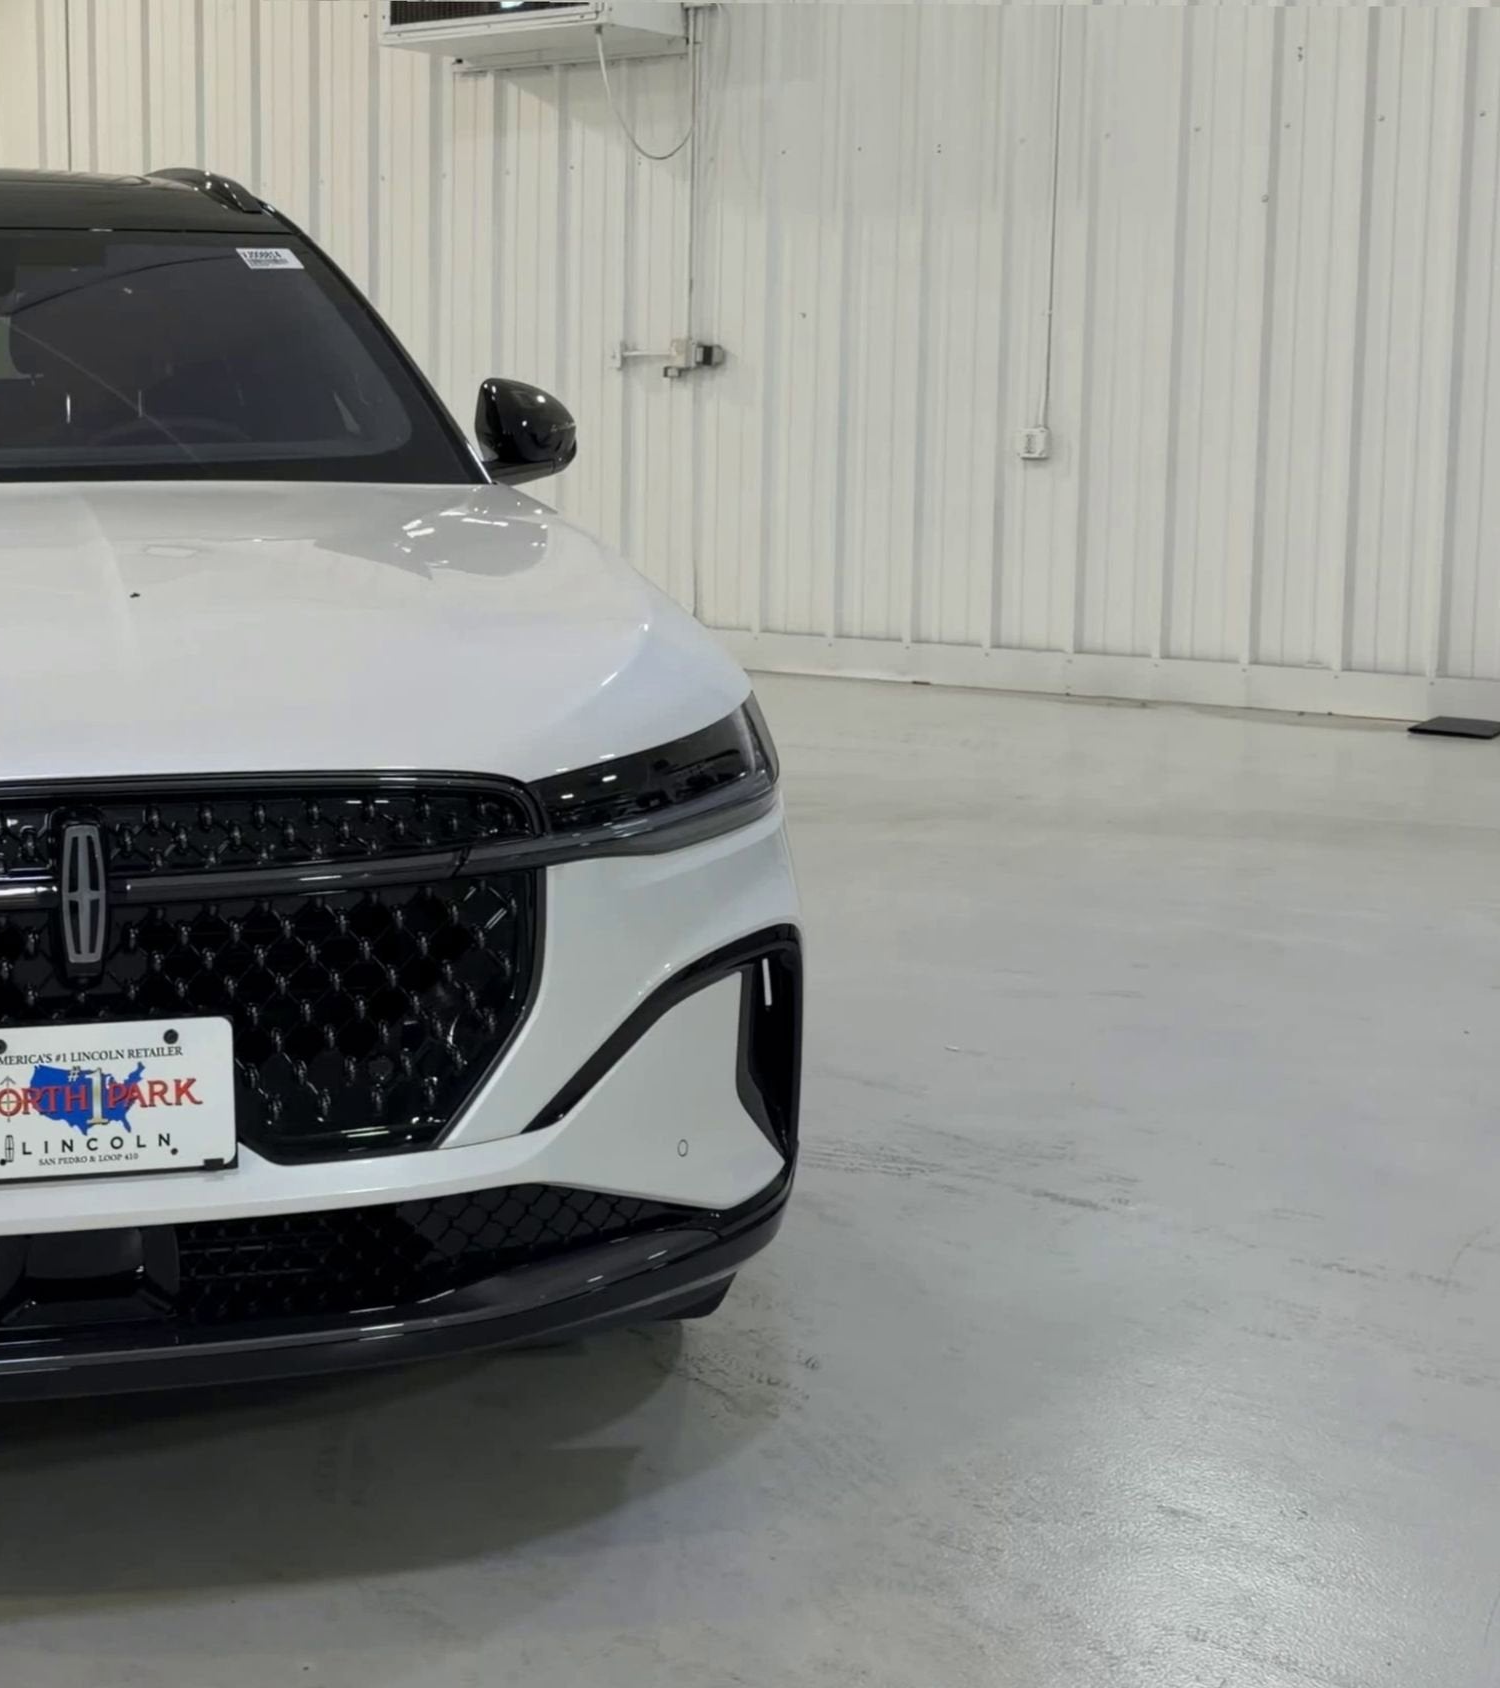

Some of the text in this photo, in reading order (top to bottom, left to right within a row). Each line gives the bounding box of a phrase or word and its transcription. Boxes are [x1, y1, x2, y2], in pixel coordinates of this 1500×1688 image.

[55, 1052, 67, 1063] #1
[71, 1049, 125, 1062] LINCOLN
[127, 1045, 184, 1059] RETAILER
[107, 1077, 203, 1111] PARK
[22, 1132, 171, 1156] LINCOLN
[38, 1152, 139, 1166] SAN PEDRO & LOOP 410
